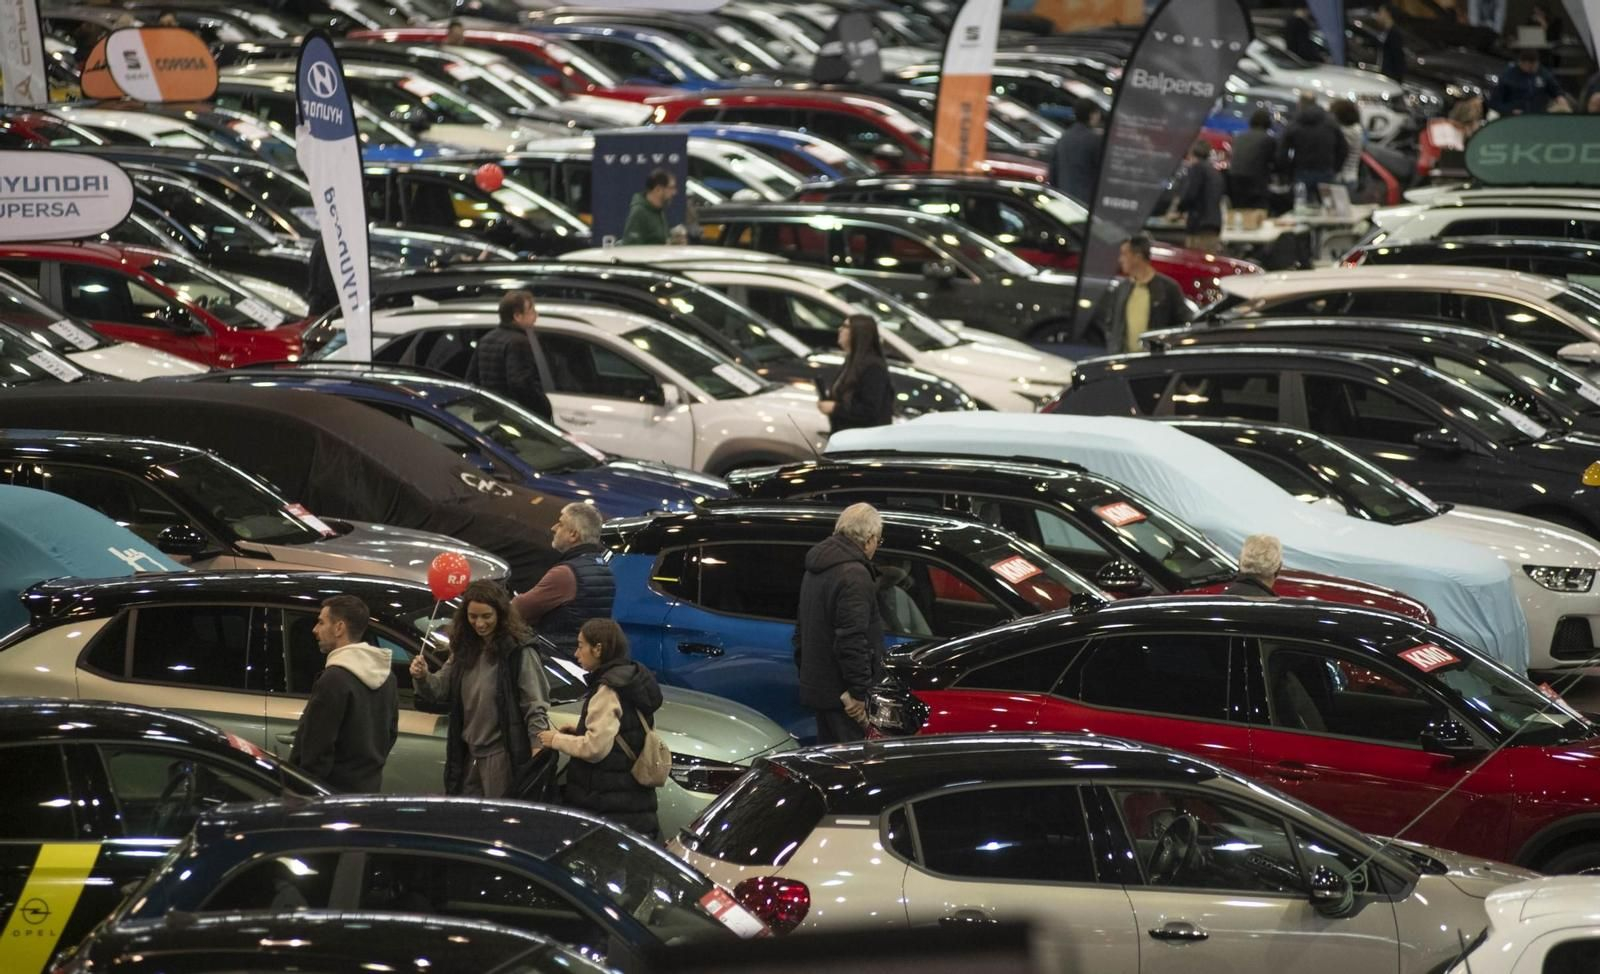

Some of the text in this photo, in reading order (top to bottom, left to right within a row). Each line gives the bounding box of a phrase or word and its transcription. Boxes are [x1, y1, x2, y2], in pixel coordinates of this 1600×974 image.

[1153, 30, 1242, 51] VOLVO
[1131, 68, 1215, 98] Balpersa
[603, 152, 680, 165] VOLVO
[0, 175, 109, 193] YUNDAI
[12, 929, 56, 937] OPEL
